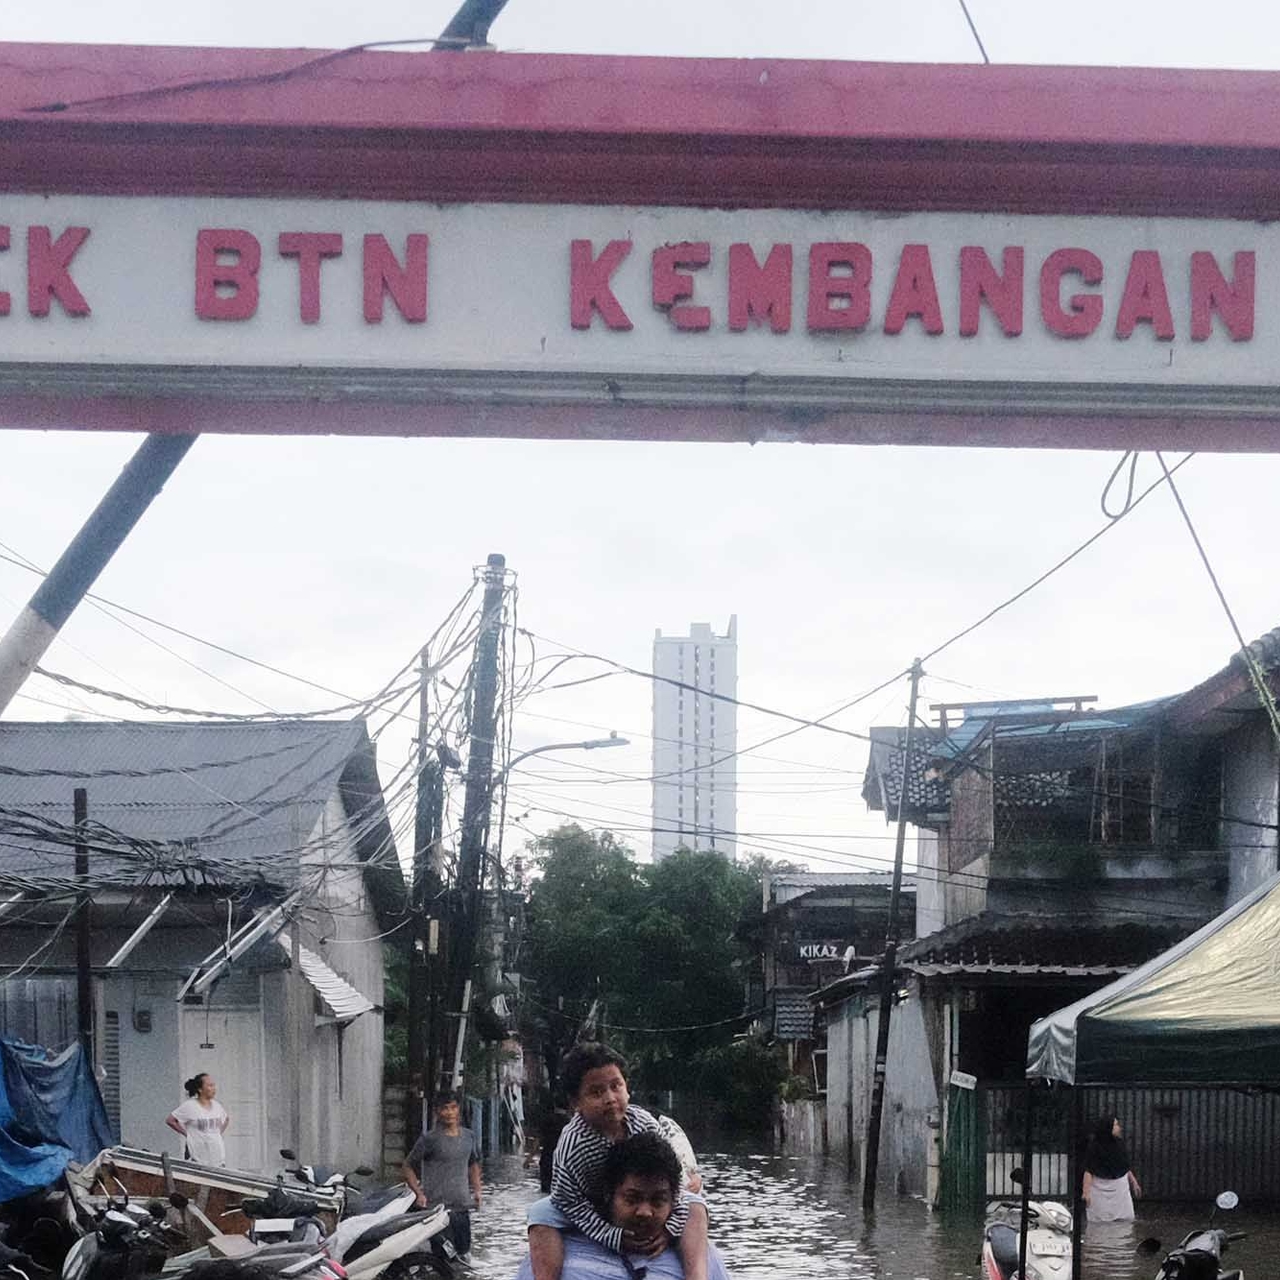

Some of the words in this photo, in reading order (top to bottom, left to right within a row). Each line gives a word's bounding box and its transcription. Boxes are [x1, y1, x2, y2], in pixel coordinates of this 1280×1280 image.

[195, 228, 429, 324] BTN
[570, 237, 1256, 342] KEMBANGAN
[799, 943, 838, 959] KIKAZ
